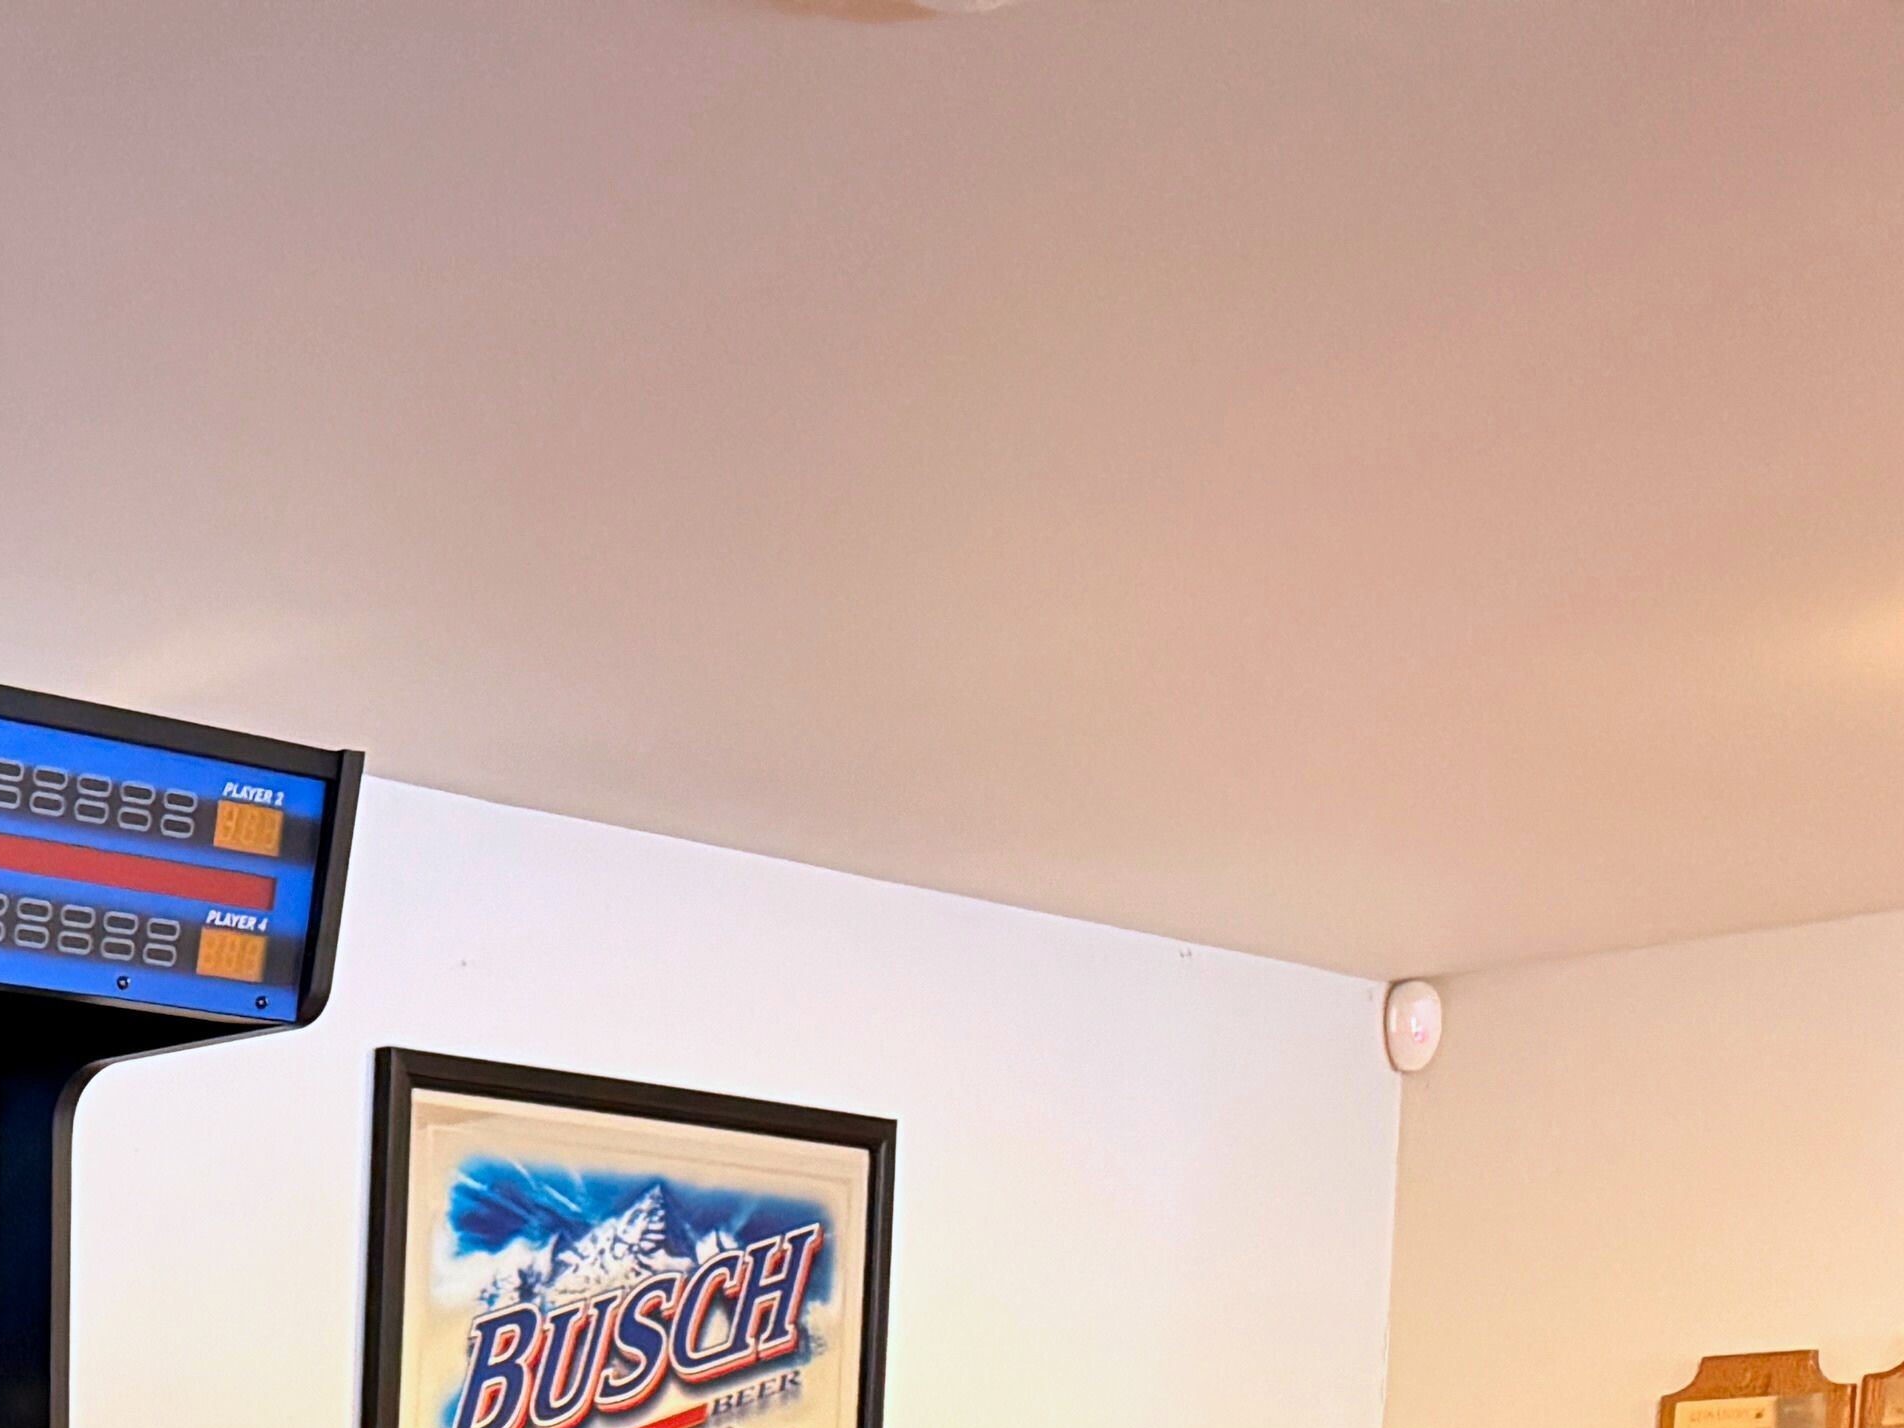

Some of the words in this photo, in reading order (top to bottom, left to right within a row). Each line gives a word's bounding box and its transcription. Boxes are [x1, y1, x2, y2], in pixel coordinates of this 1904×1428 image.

[224, 781, 272, 803] PLAYER
[275, 791, 283, 806] 2
[206, 909, 255, 929] PLAYER
[258, 918, 268, 931] 4
[710, 1369, 801, 1417] BEER
